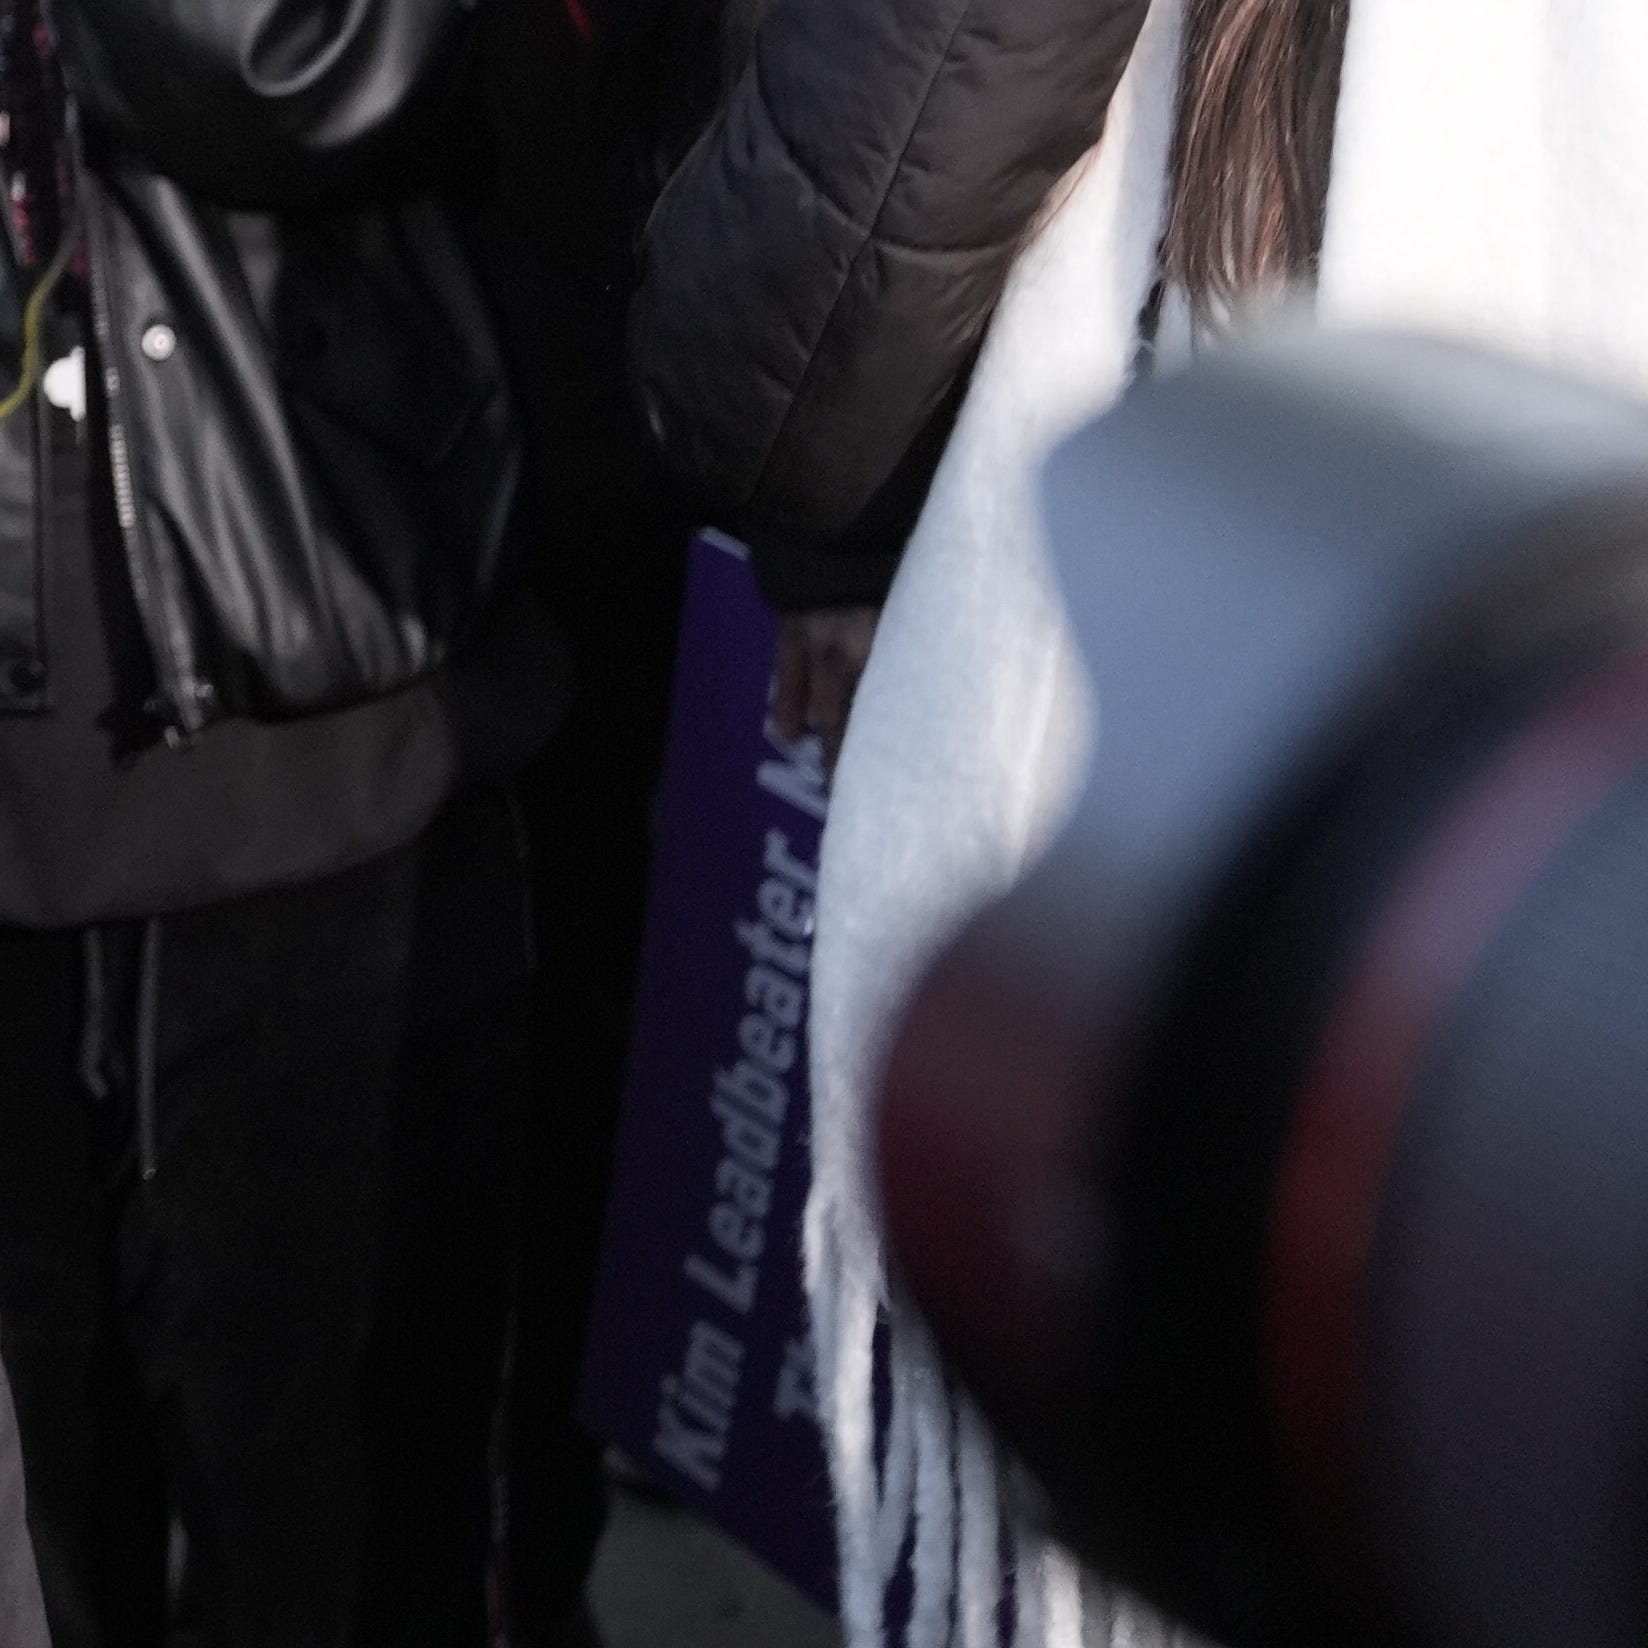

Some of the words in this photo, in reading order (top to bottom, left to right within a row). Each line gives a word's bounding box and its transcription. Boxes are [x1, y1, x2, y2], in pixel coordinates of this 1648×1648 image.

[756, 677, 828, 819] M
[683, 826, 818, 1312] Leadbeater
[651, 1318, 746, 1492] Kim
